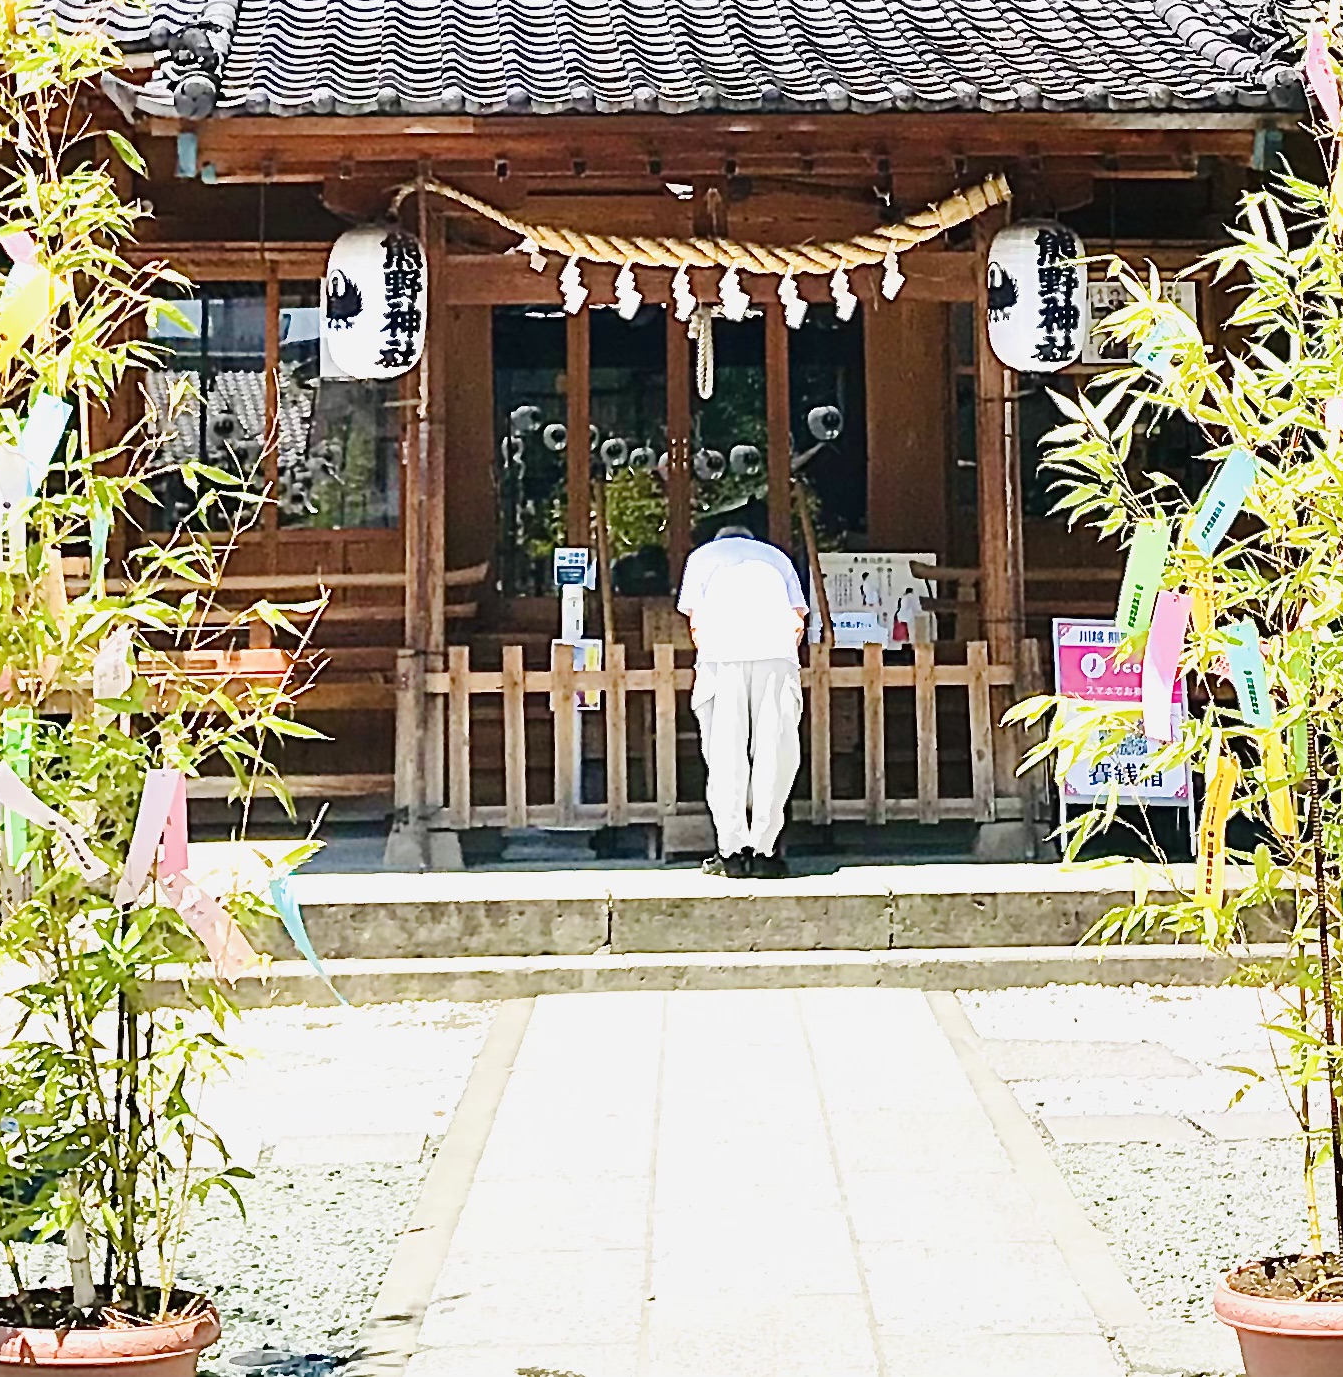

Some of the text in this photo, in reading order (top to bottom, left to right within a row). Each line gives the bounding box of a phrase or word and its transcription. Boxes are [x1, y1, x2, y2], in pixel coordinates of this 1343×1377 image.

[374, 232, 424, 368] 熊野神社
[1031, 229, 1081, 362] 熊野神社
